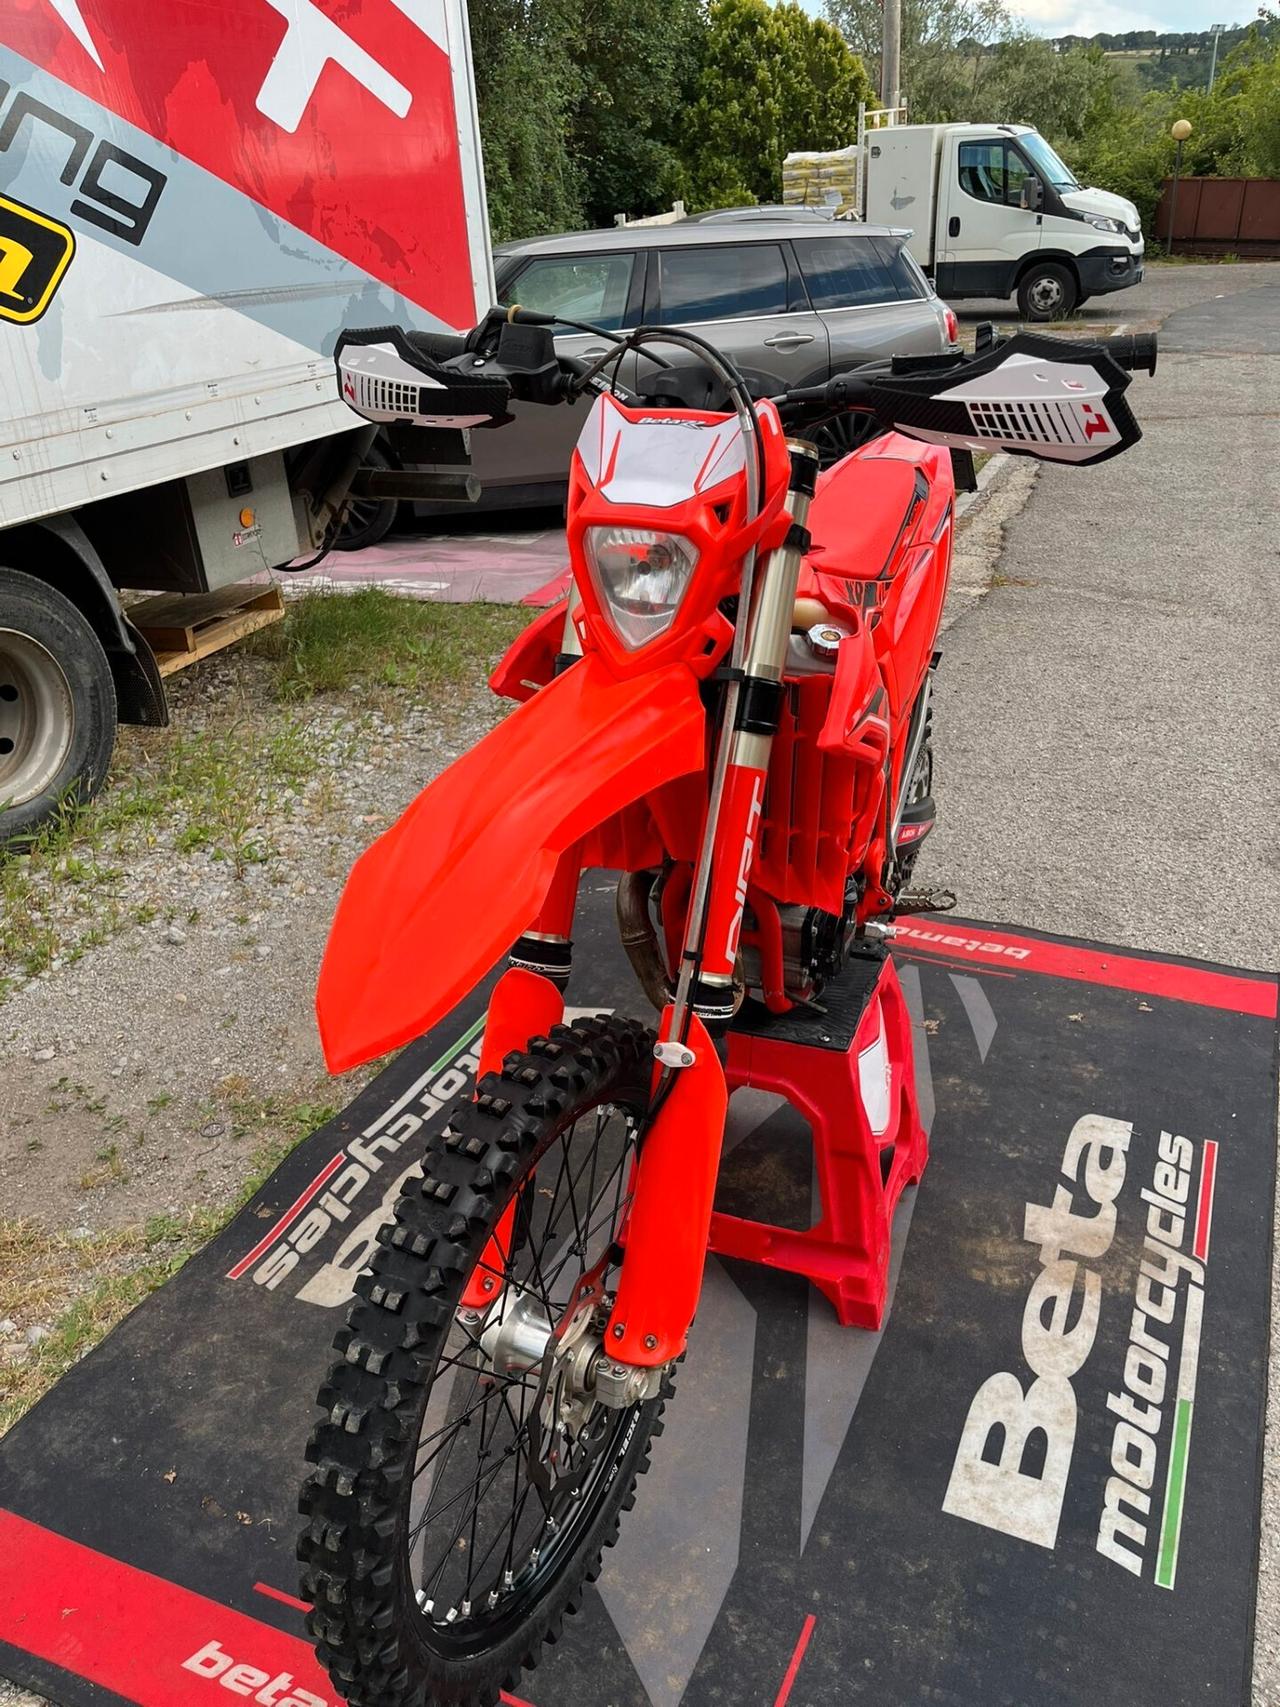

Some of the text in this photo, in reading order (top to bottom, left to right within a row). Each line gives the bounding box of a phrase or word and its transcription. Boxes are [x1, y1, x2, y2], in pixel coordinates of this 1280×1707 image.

[0, 78, 168, 246] ng
[253, 1034, 485, 1291] torcycles
[942, 1113, 1133, 1550] Beta
[1096, 1130, 1205, 1577] motorcycles
